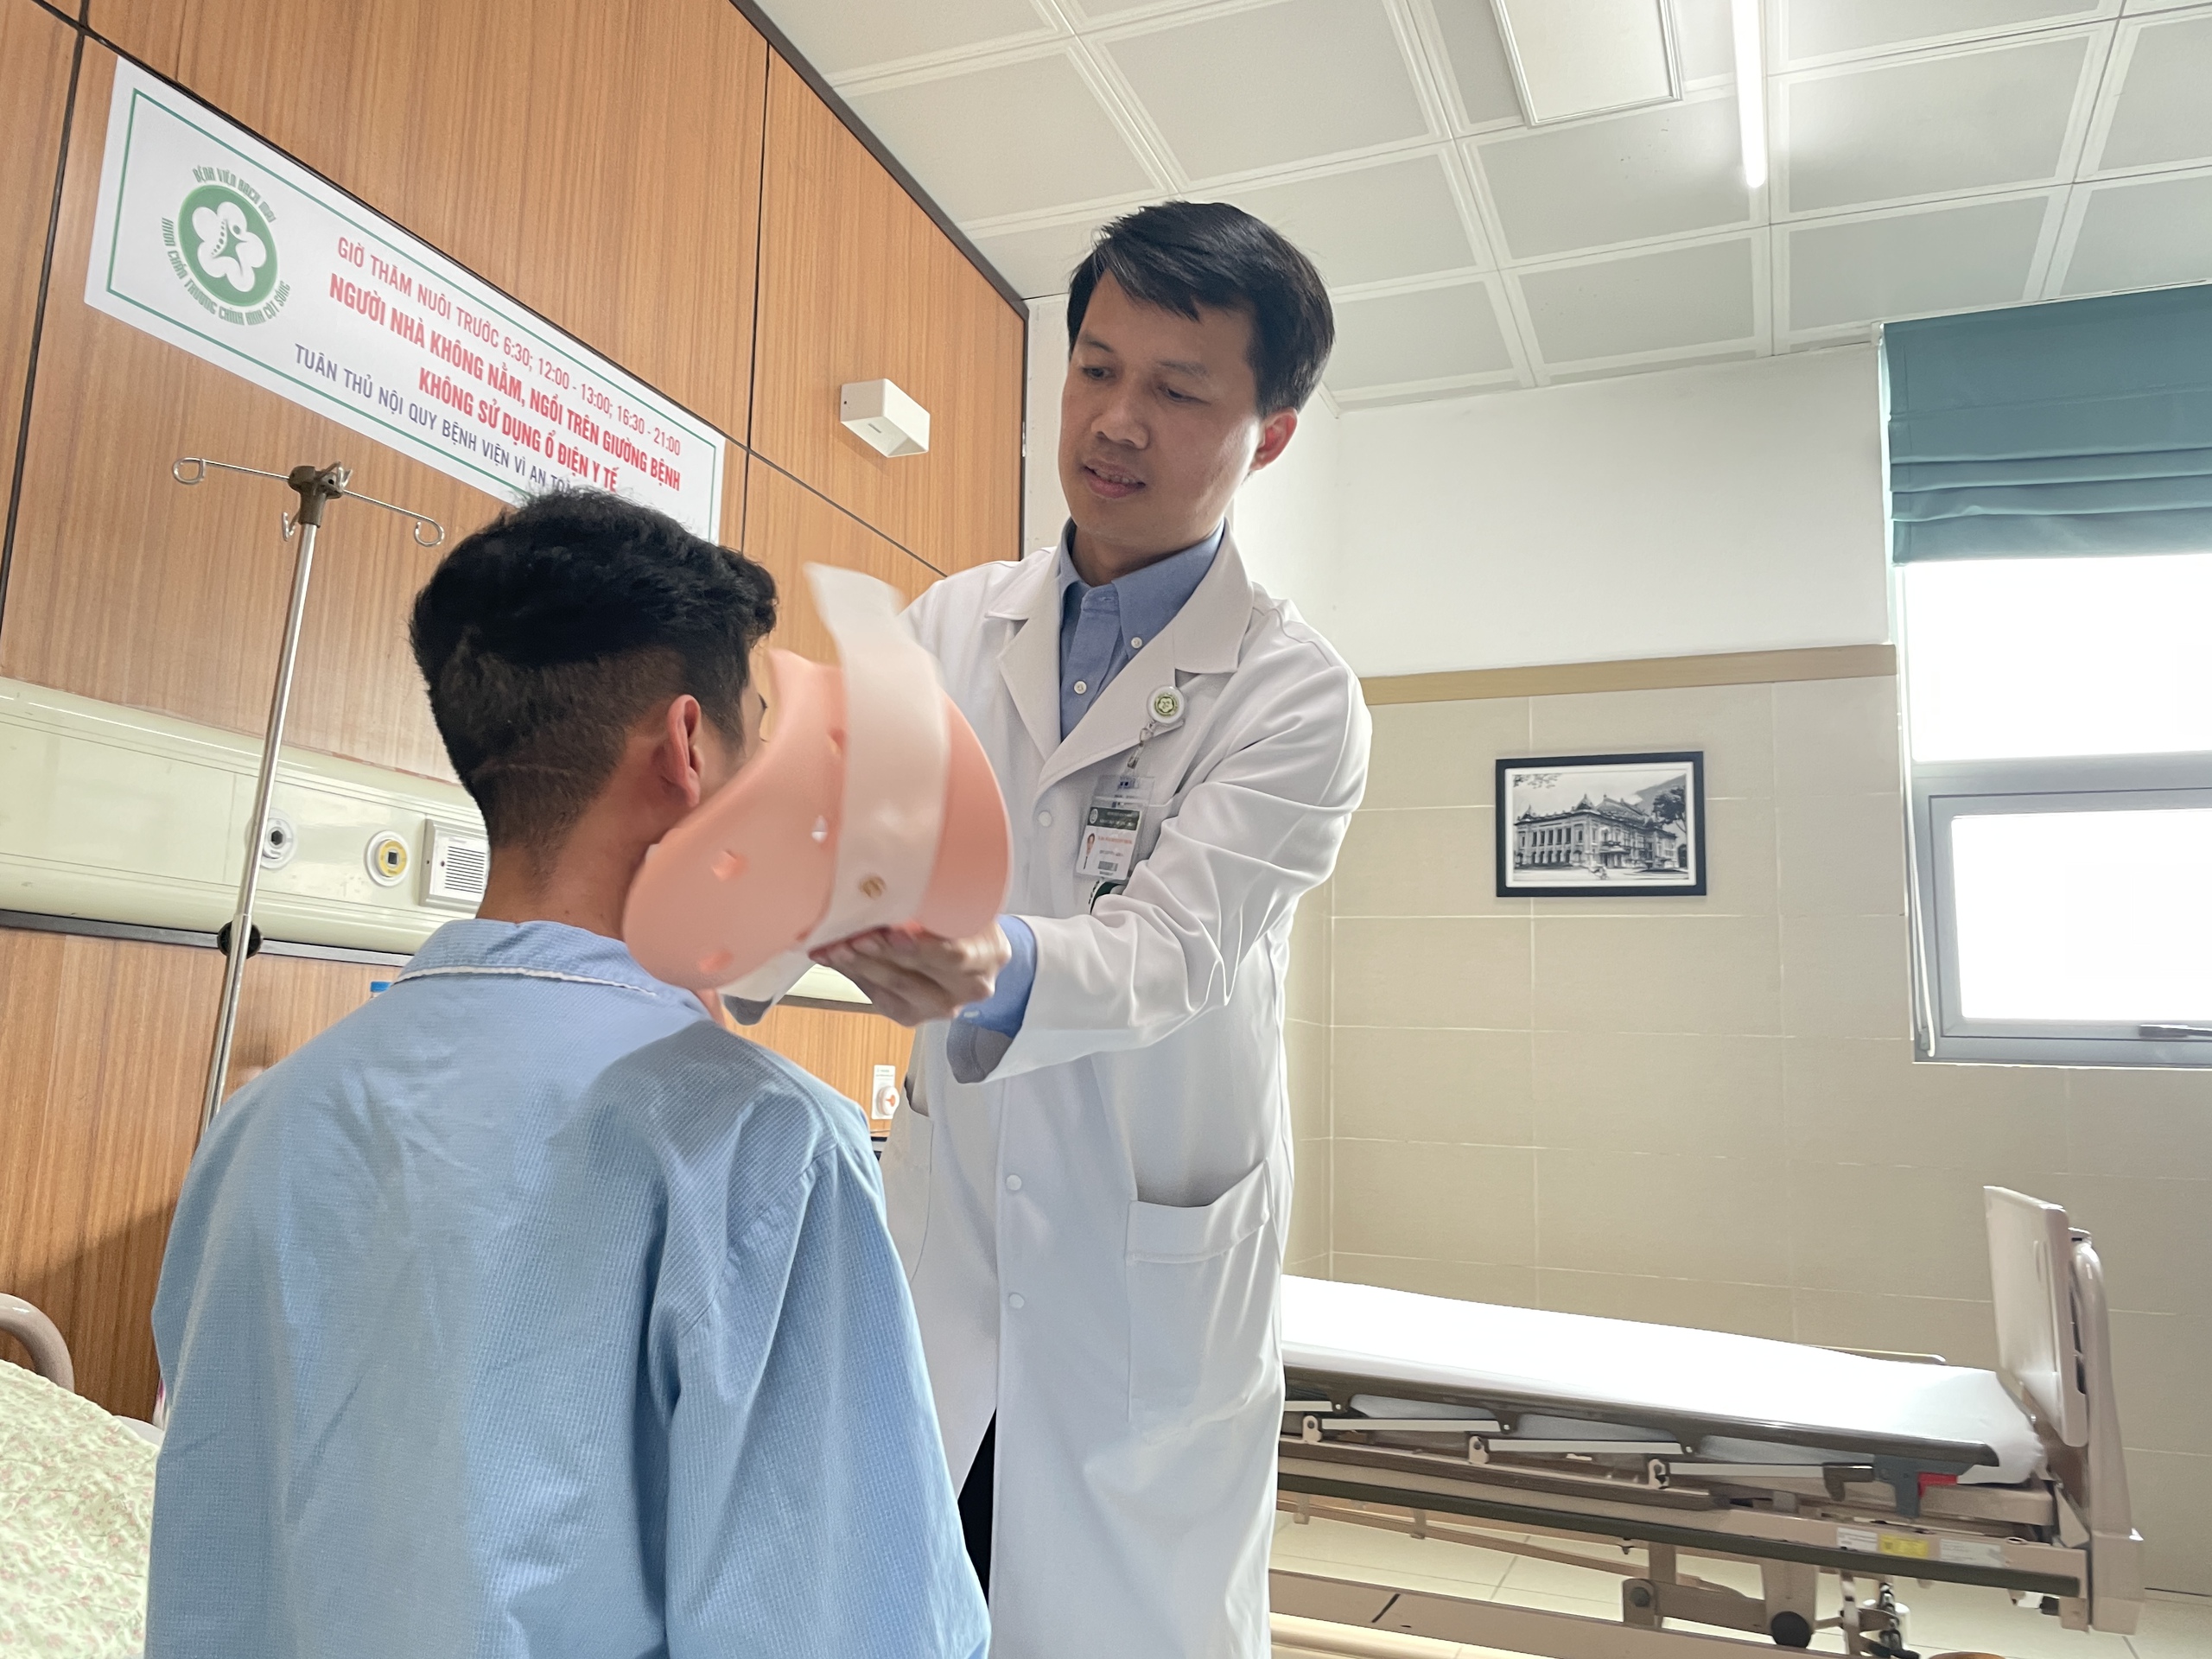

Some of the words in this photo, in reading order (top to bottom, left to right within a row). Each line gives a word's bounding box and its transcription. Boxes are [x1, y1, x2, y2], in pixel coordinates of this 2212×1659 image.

[295, 343, 337, 382] TUÂN
[344, 367, 373, 398] THỦ
[378, 386, 403, 416] NỘI
[409, 403, 437, 430] QUY
[442, 419, 476, 452] BỆNH
[481, 439, 510, 468] VIỆN
[514, 455, 526, 476] VÌ
[530, 465, 546, 487] AN
[550, 474, 572, 495] TOÀ
[329, 273, 385, 325] NGƯỜI
[390, 307, 426, 349] NHÀ
[429, 330, 484, 380] KHÔNG
[487, 361, 525, 407] NẰM,
[567, 409, 600, 446] TRÊN
[603, 430, 647, 474] GIƯỜNG
[650, 456, 681, 492] BỆNH
[338, 237, 365, 268] GIỜ
[370, 255, 412, 296] THĂM
[417, 283, 451, 320] NUÔI
[456, 306, 499, 347] TRƯỚC
[504, 336, 533, 372] 6:30;
[538, 358, 569, 390] 12:00
[581, 384, 613, 419] 13:00;
[617, 405, 645, 435] 16:30
[653, 428, 681, 456] 21:00
[419, 367, 474, 416] KHÔNG
[478, 398, 500, 429] SỬ
[502, 413, 541, 453] DỤNG
[545, 429, 556, 459] Ổ
[557, 442, 588, 477] ĐIỆN
[592, 460, 601, 483] Y
[603, 467, 620, 493] TẾ
